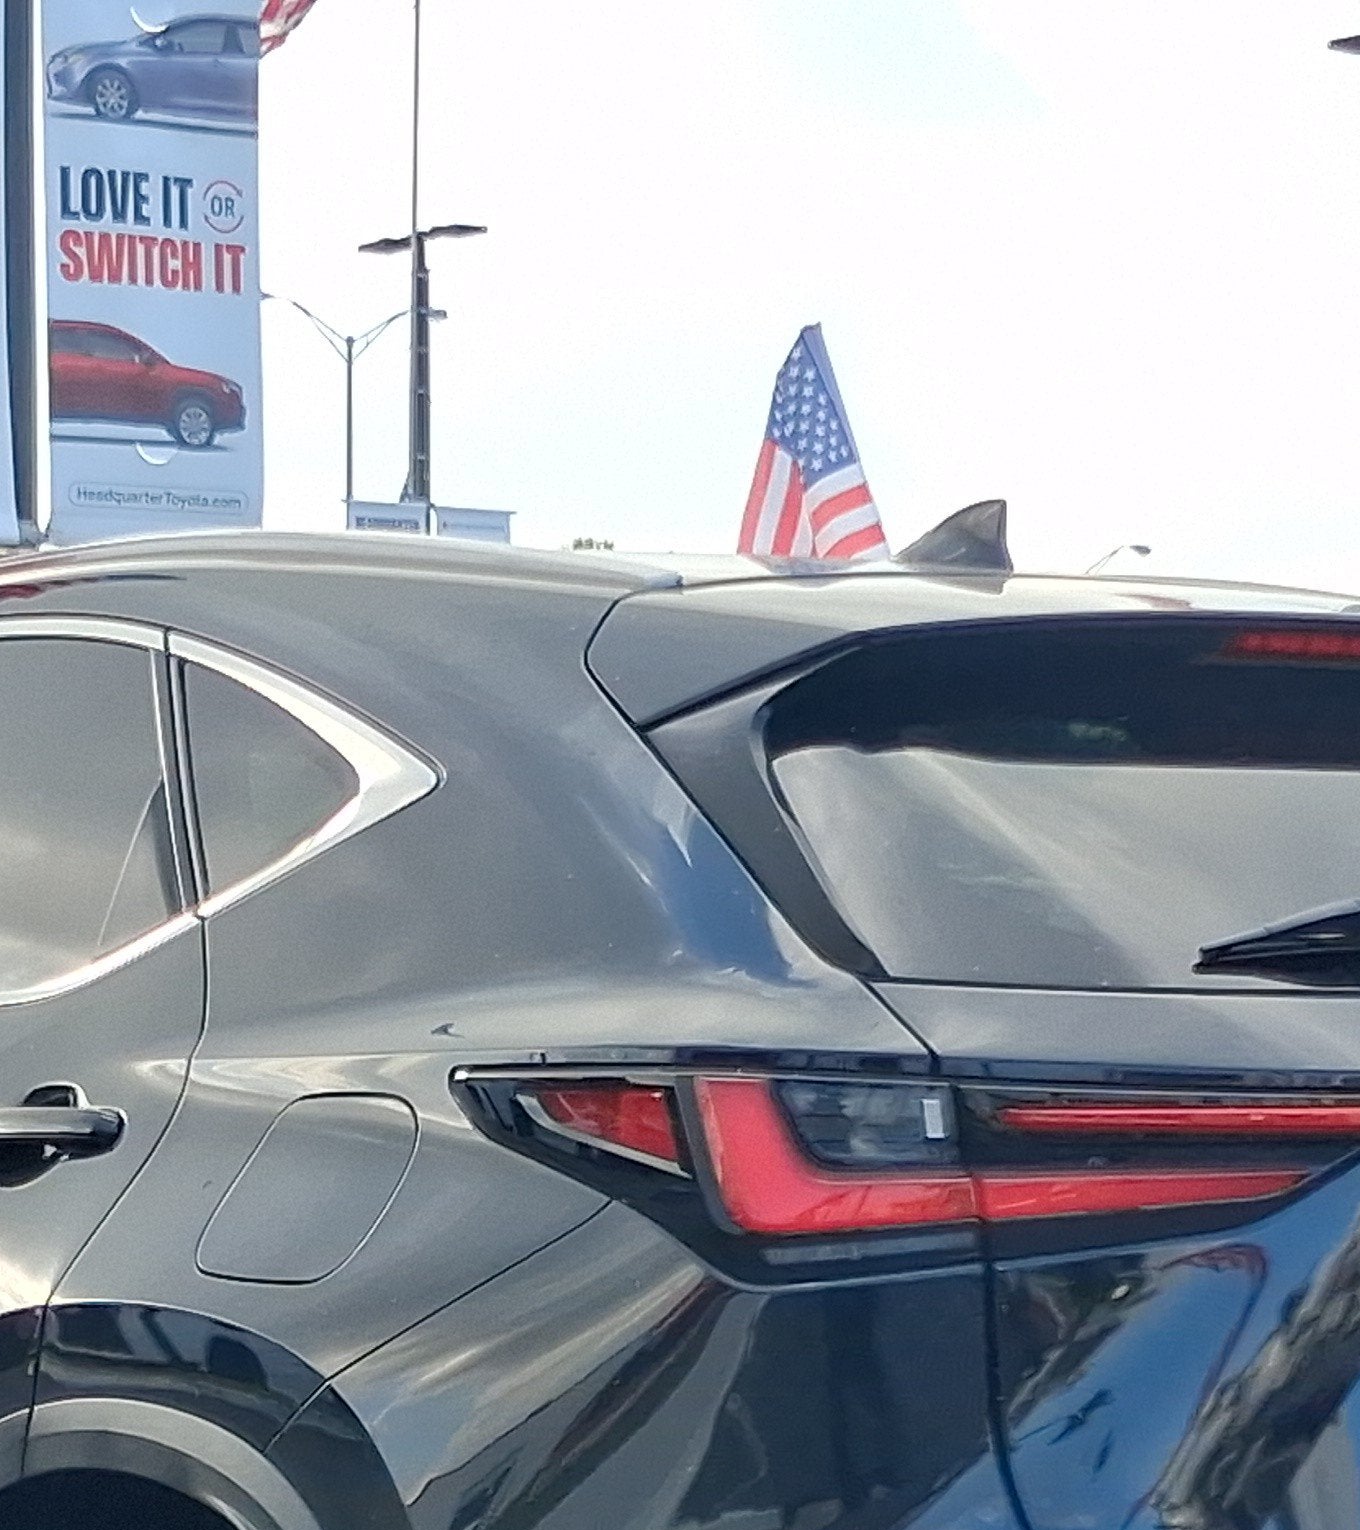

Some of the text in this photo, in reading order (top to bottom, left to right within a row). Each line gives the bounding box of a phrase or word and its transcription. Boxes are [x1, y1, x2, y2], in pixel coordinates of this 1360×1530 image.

[59, 165, 236, 231] LOVE IT OR
[58, 229, 247, 296] SWITCH IT
